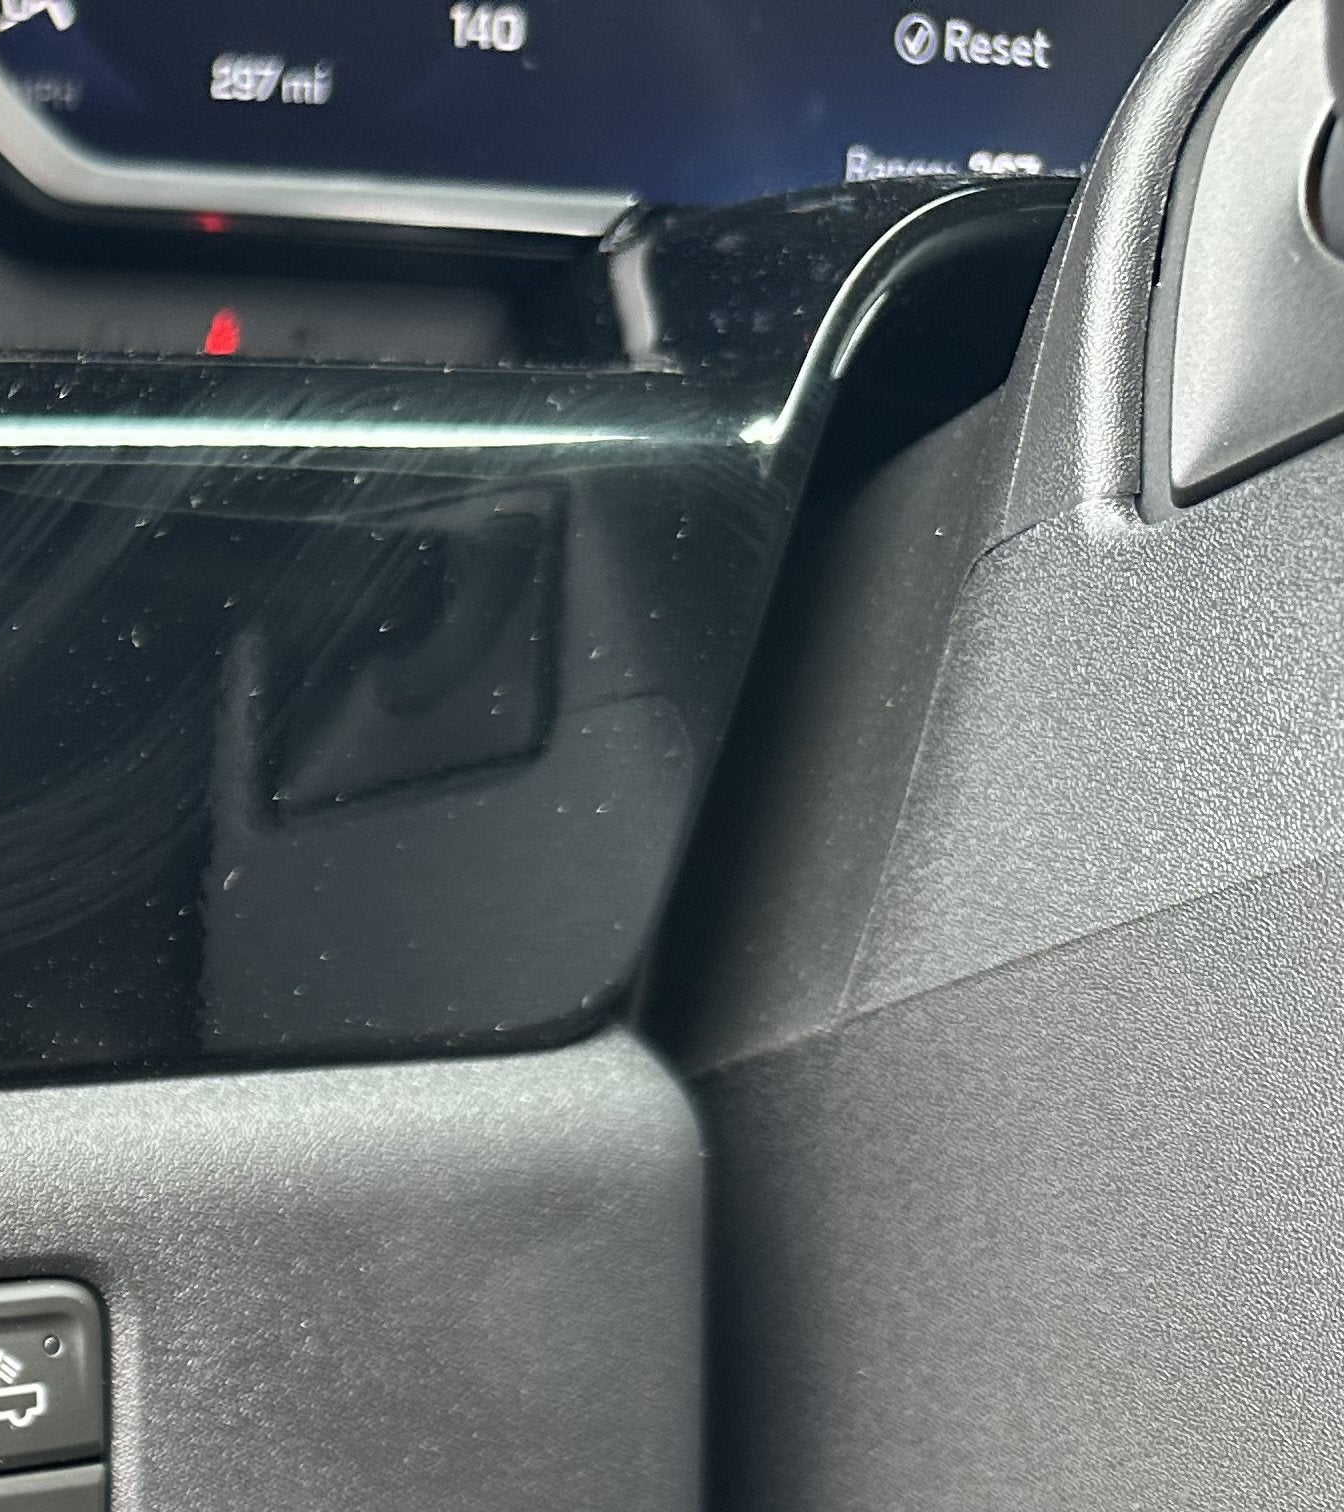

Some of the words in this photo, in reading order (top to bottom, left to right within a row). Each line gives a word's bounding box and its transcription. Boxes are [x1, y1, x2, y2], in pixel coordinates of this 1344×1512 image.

[450, 3, 527, 51] 140
[944, 18, 1050, 68] Reset
[211, 54, 283, 101] 297
[282, 63, 331, 104] mi
